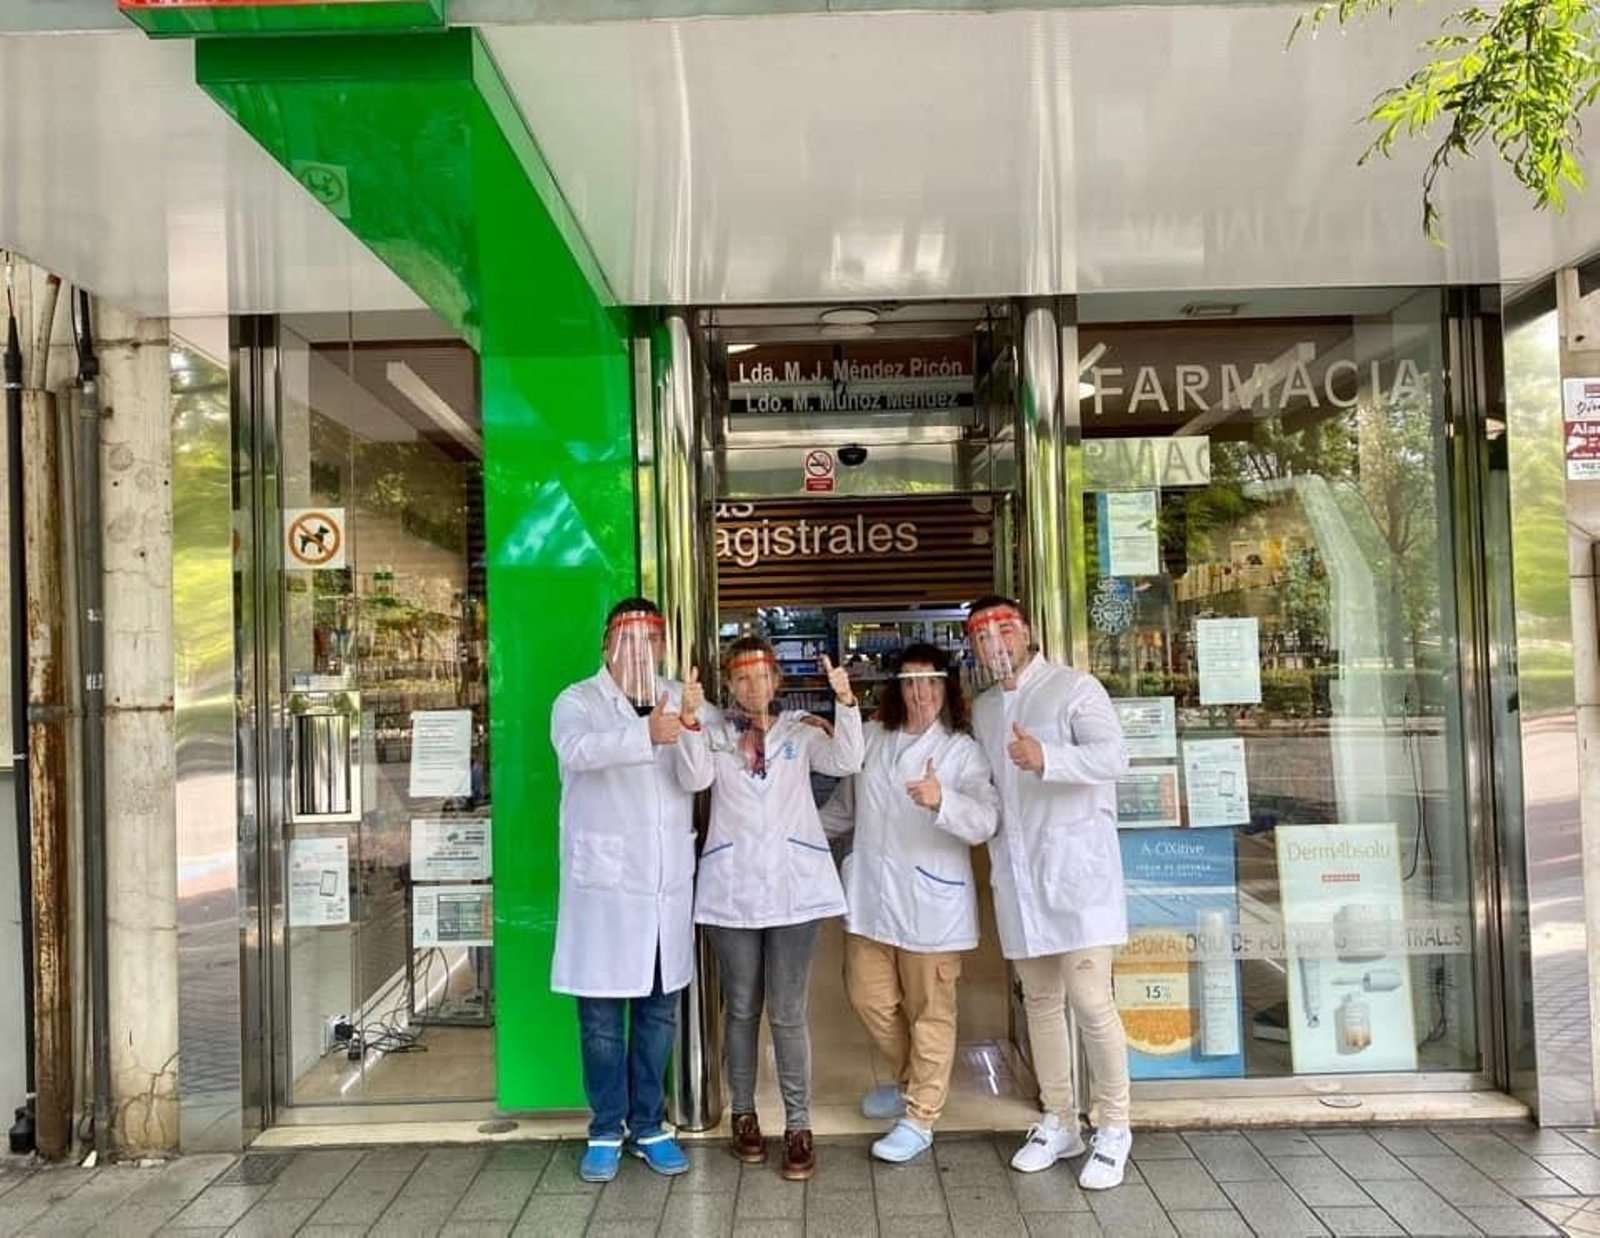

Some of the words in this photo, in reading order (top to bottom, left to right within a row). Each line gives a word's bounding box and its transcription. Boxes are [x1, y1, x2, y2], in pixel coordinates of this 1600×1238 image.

[738, 361, 779, 384] Lda.
[784, 360, 805, 381] M.
[811, 359, 827, 380] J.
[909, 355, 963, 376] Picón
[1093, 358, 1421, 414] FARMACIA
[746, 392, 787, 413] Ldo.
[792, 390, 815, 412] M.
[716, 514, 919, 567] agistrales
[1146, 985, 1161, 999] 15
